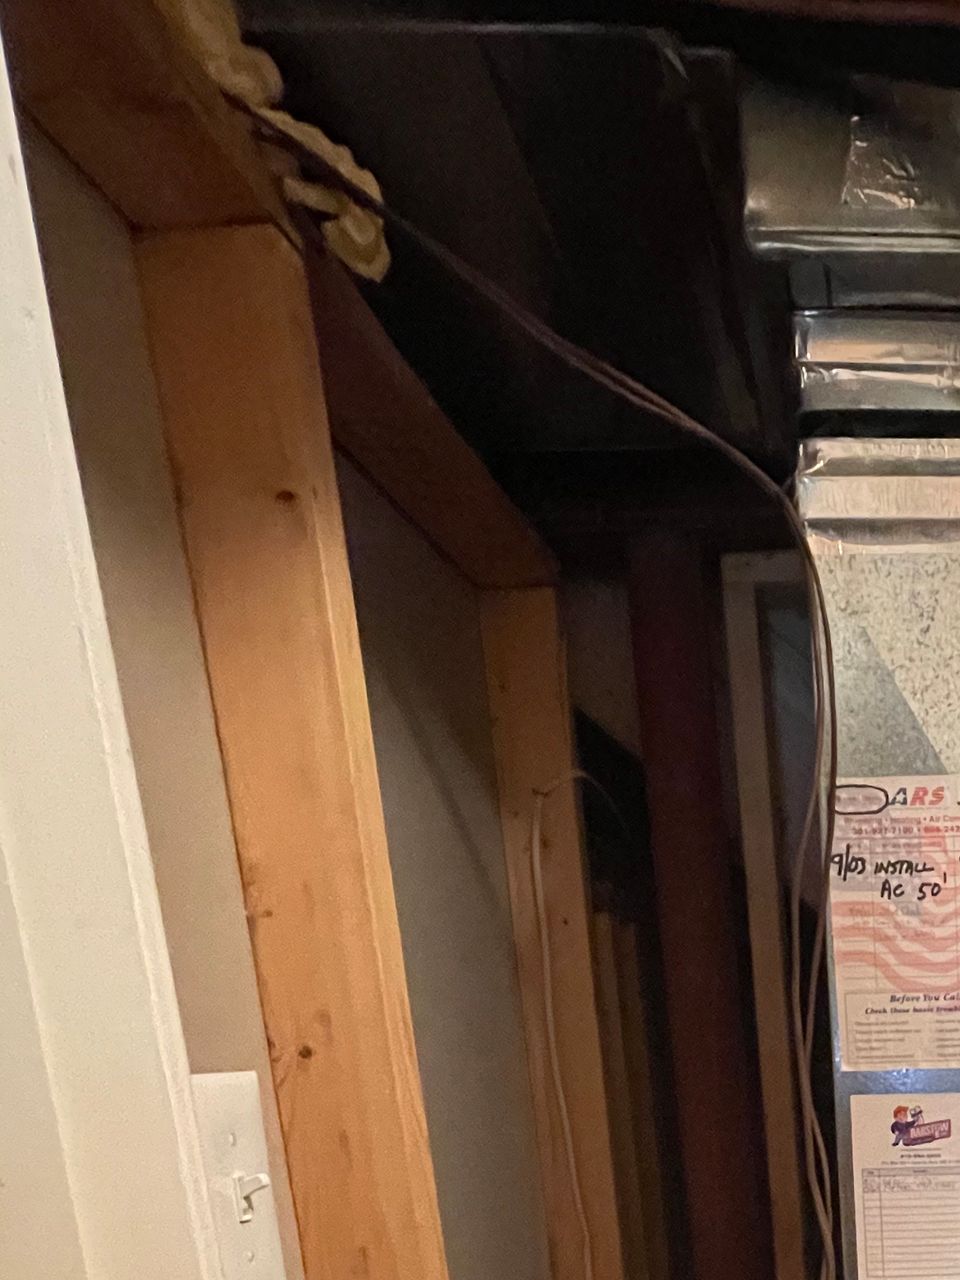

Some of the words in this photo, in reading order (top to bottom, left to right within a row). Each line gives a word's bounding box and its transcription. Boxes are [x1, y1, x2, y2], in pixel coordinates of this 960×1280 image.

[888, 786, 945, 806] ARS
[874, 860, 935, 877] INSTALL
[880, 878, 905, 900] AC
[890, 994, 921, 1005] Before
[923, 993, 940, 1002] You
